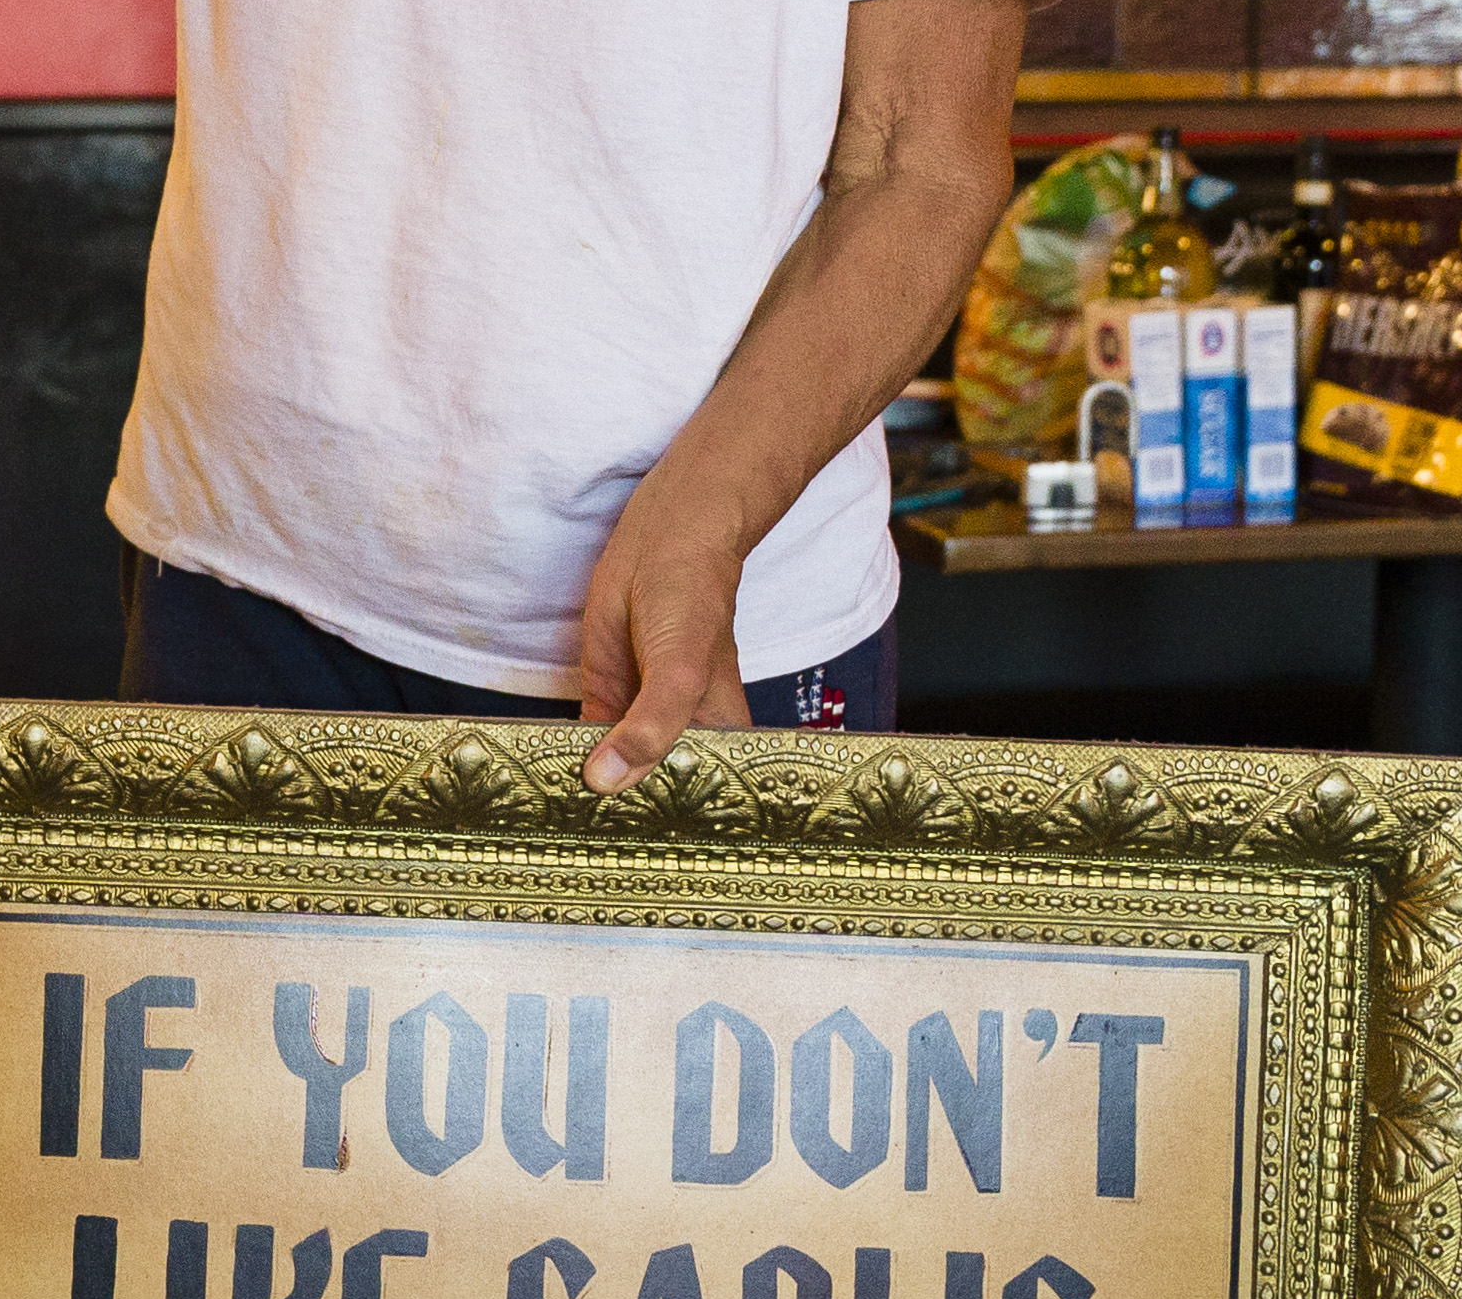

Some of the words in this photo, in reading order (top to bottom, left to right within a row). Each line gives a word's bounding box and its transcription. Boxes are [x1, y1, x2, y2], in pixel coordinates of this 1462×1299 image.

[40, 972, 198, 1160] IF
[272, 981, 610, 1183] YOU
[674, 998, 1166, 1200] DON'T
